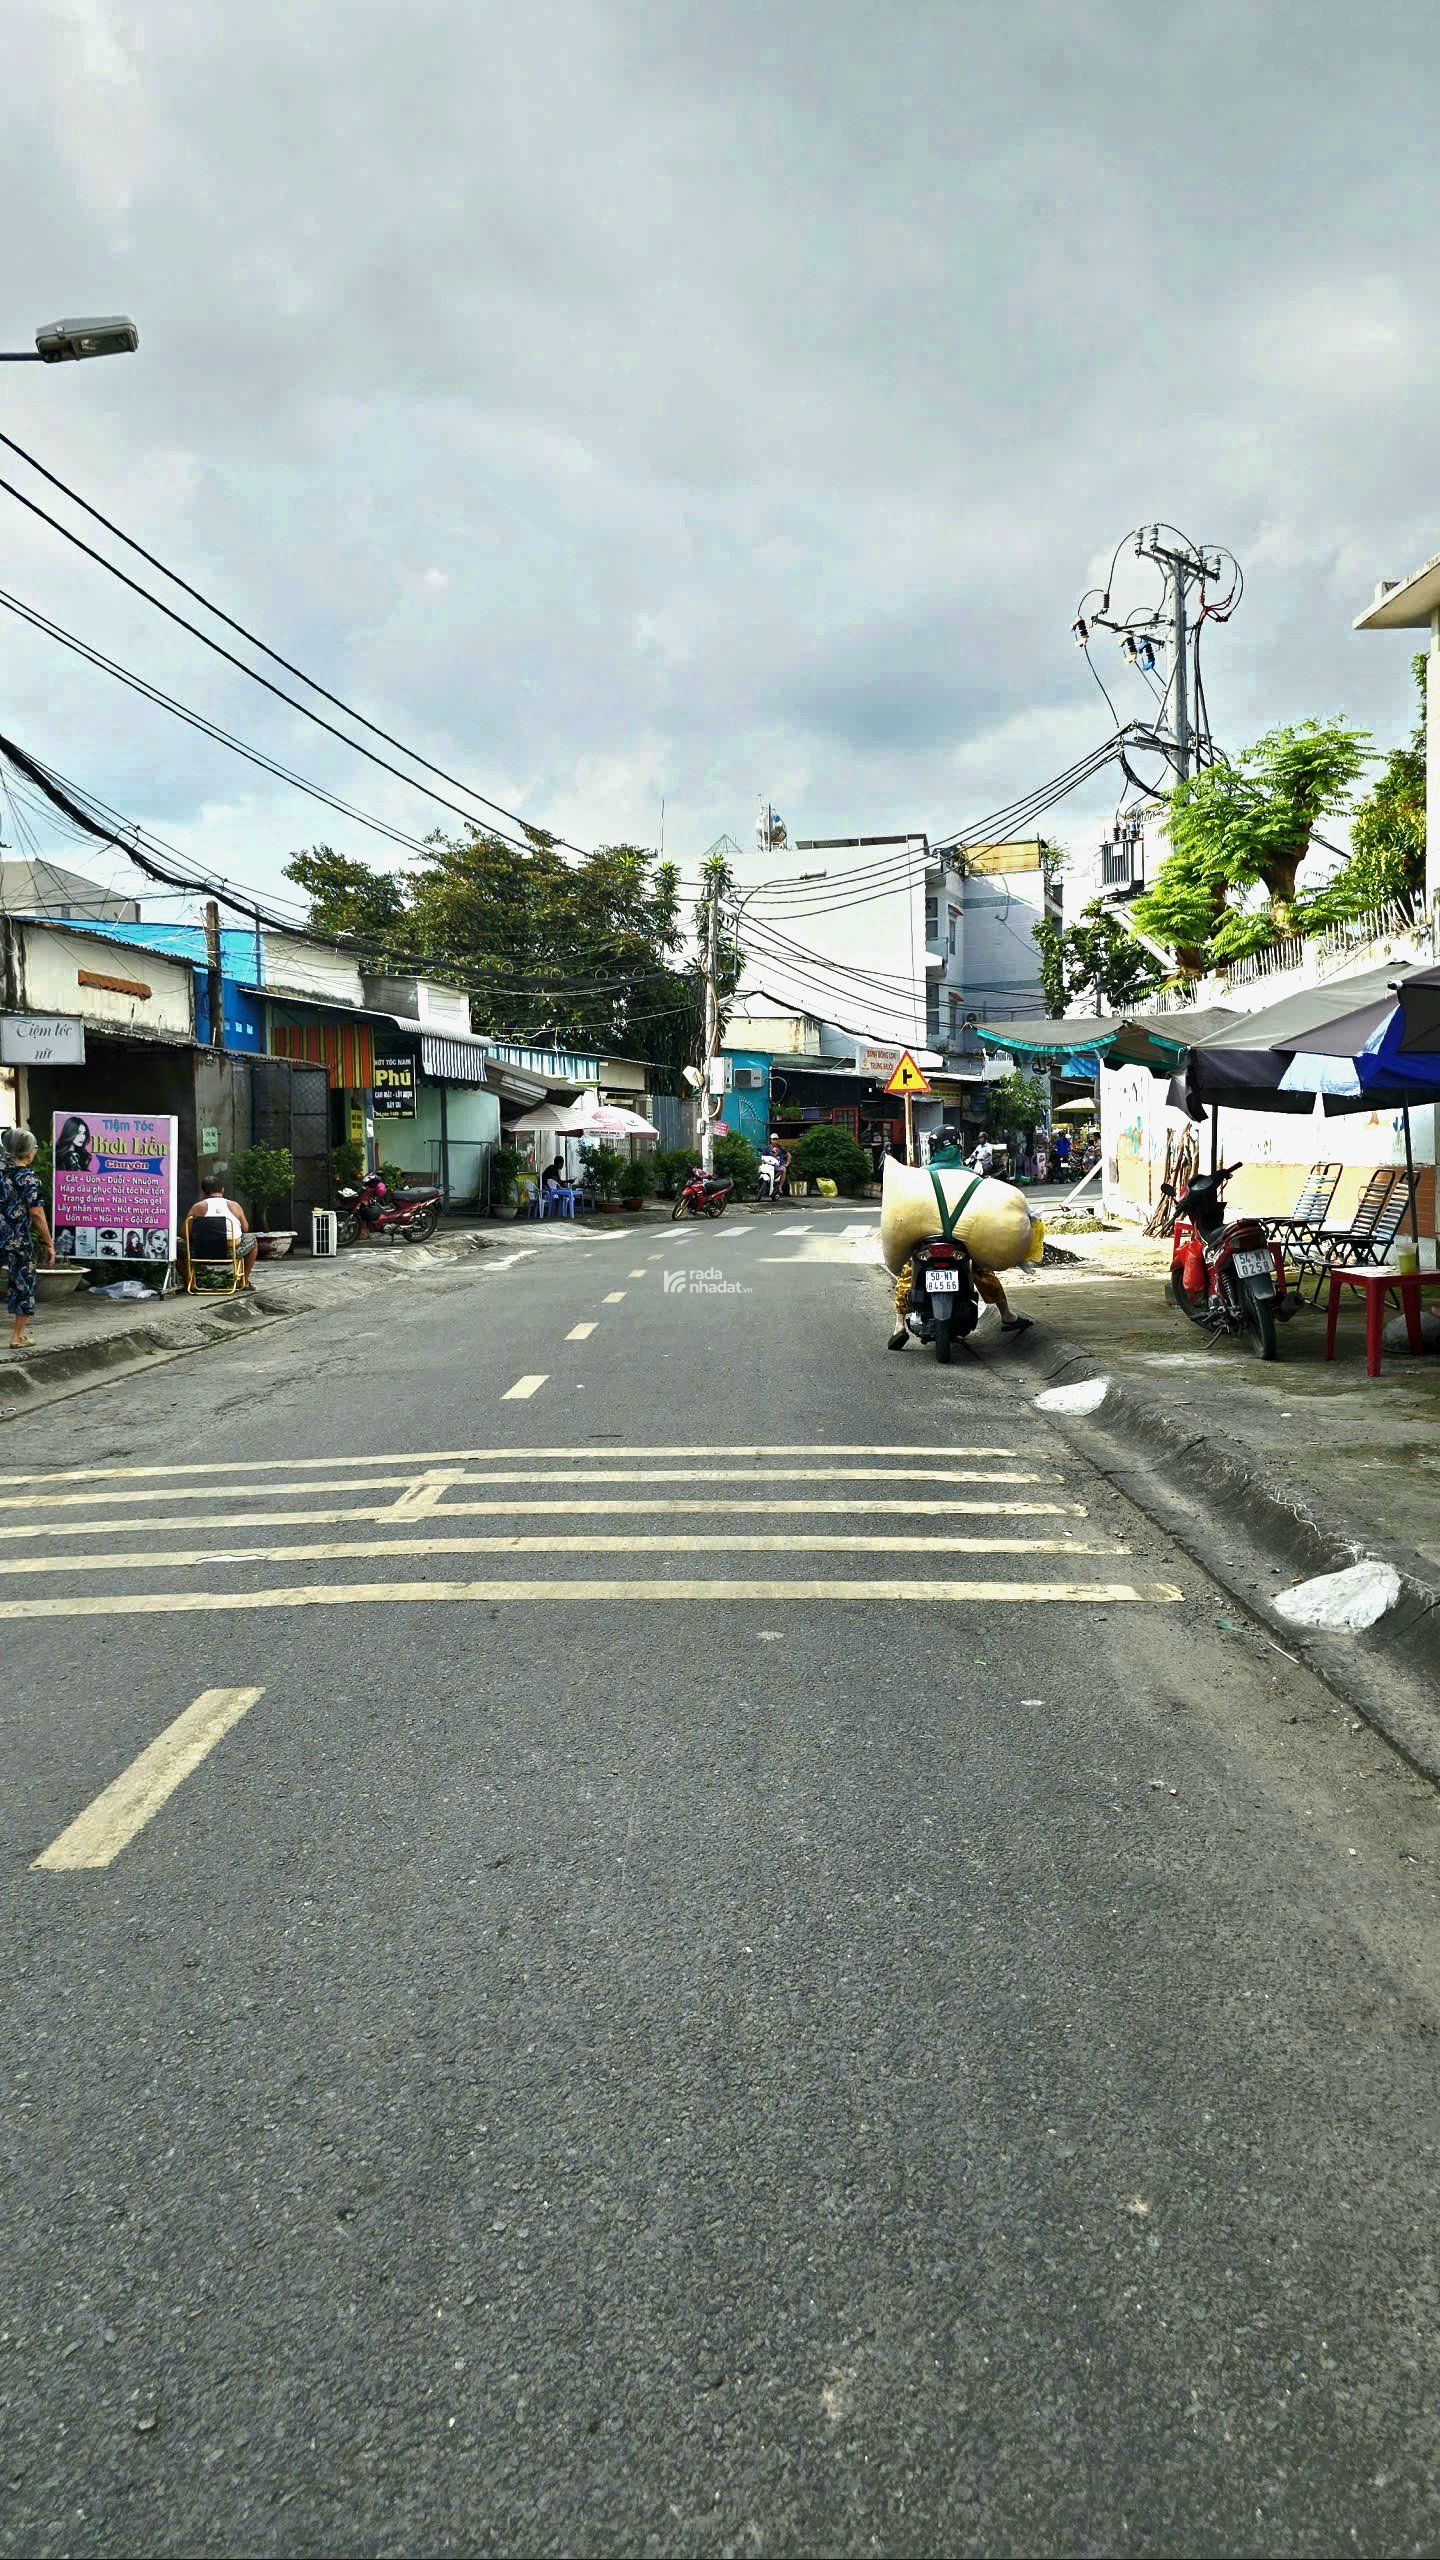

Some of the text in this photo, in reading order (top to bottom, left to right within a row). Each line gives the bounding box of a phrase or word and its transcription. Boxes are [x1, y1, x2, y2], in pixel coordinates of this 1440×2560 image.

[375, 1069, 412, 1087] Phú
[102, 1119, 154, 1133] Tiệm Tóc
[105, 1160, 149, 1171] Chuyên
[62, 1194, 85, 1204] Trang
[112, 1196, 127, 1205] Nail
[150, 1197, 162, 1206] gel
[1239, 1250, 1266, 1265] 54-N1
[1241, 1260, 1270, 1275] 0258
